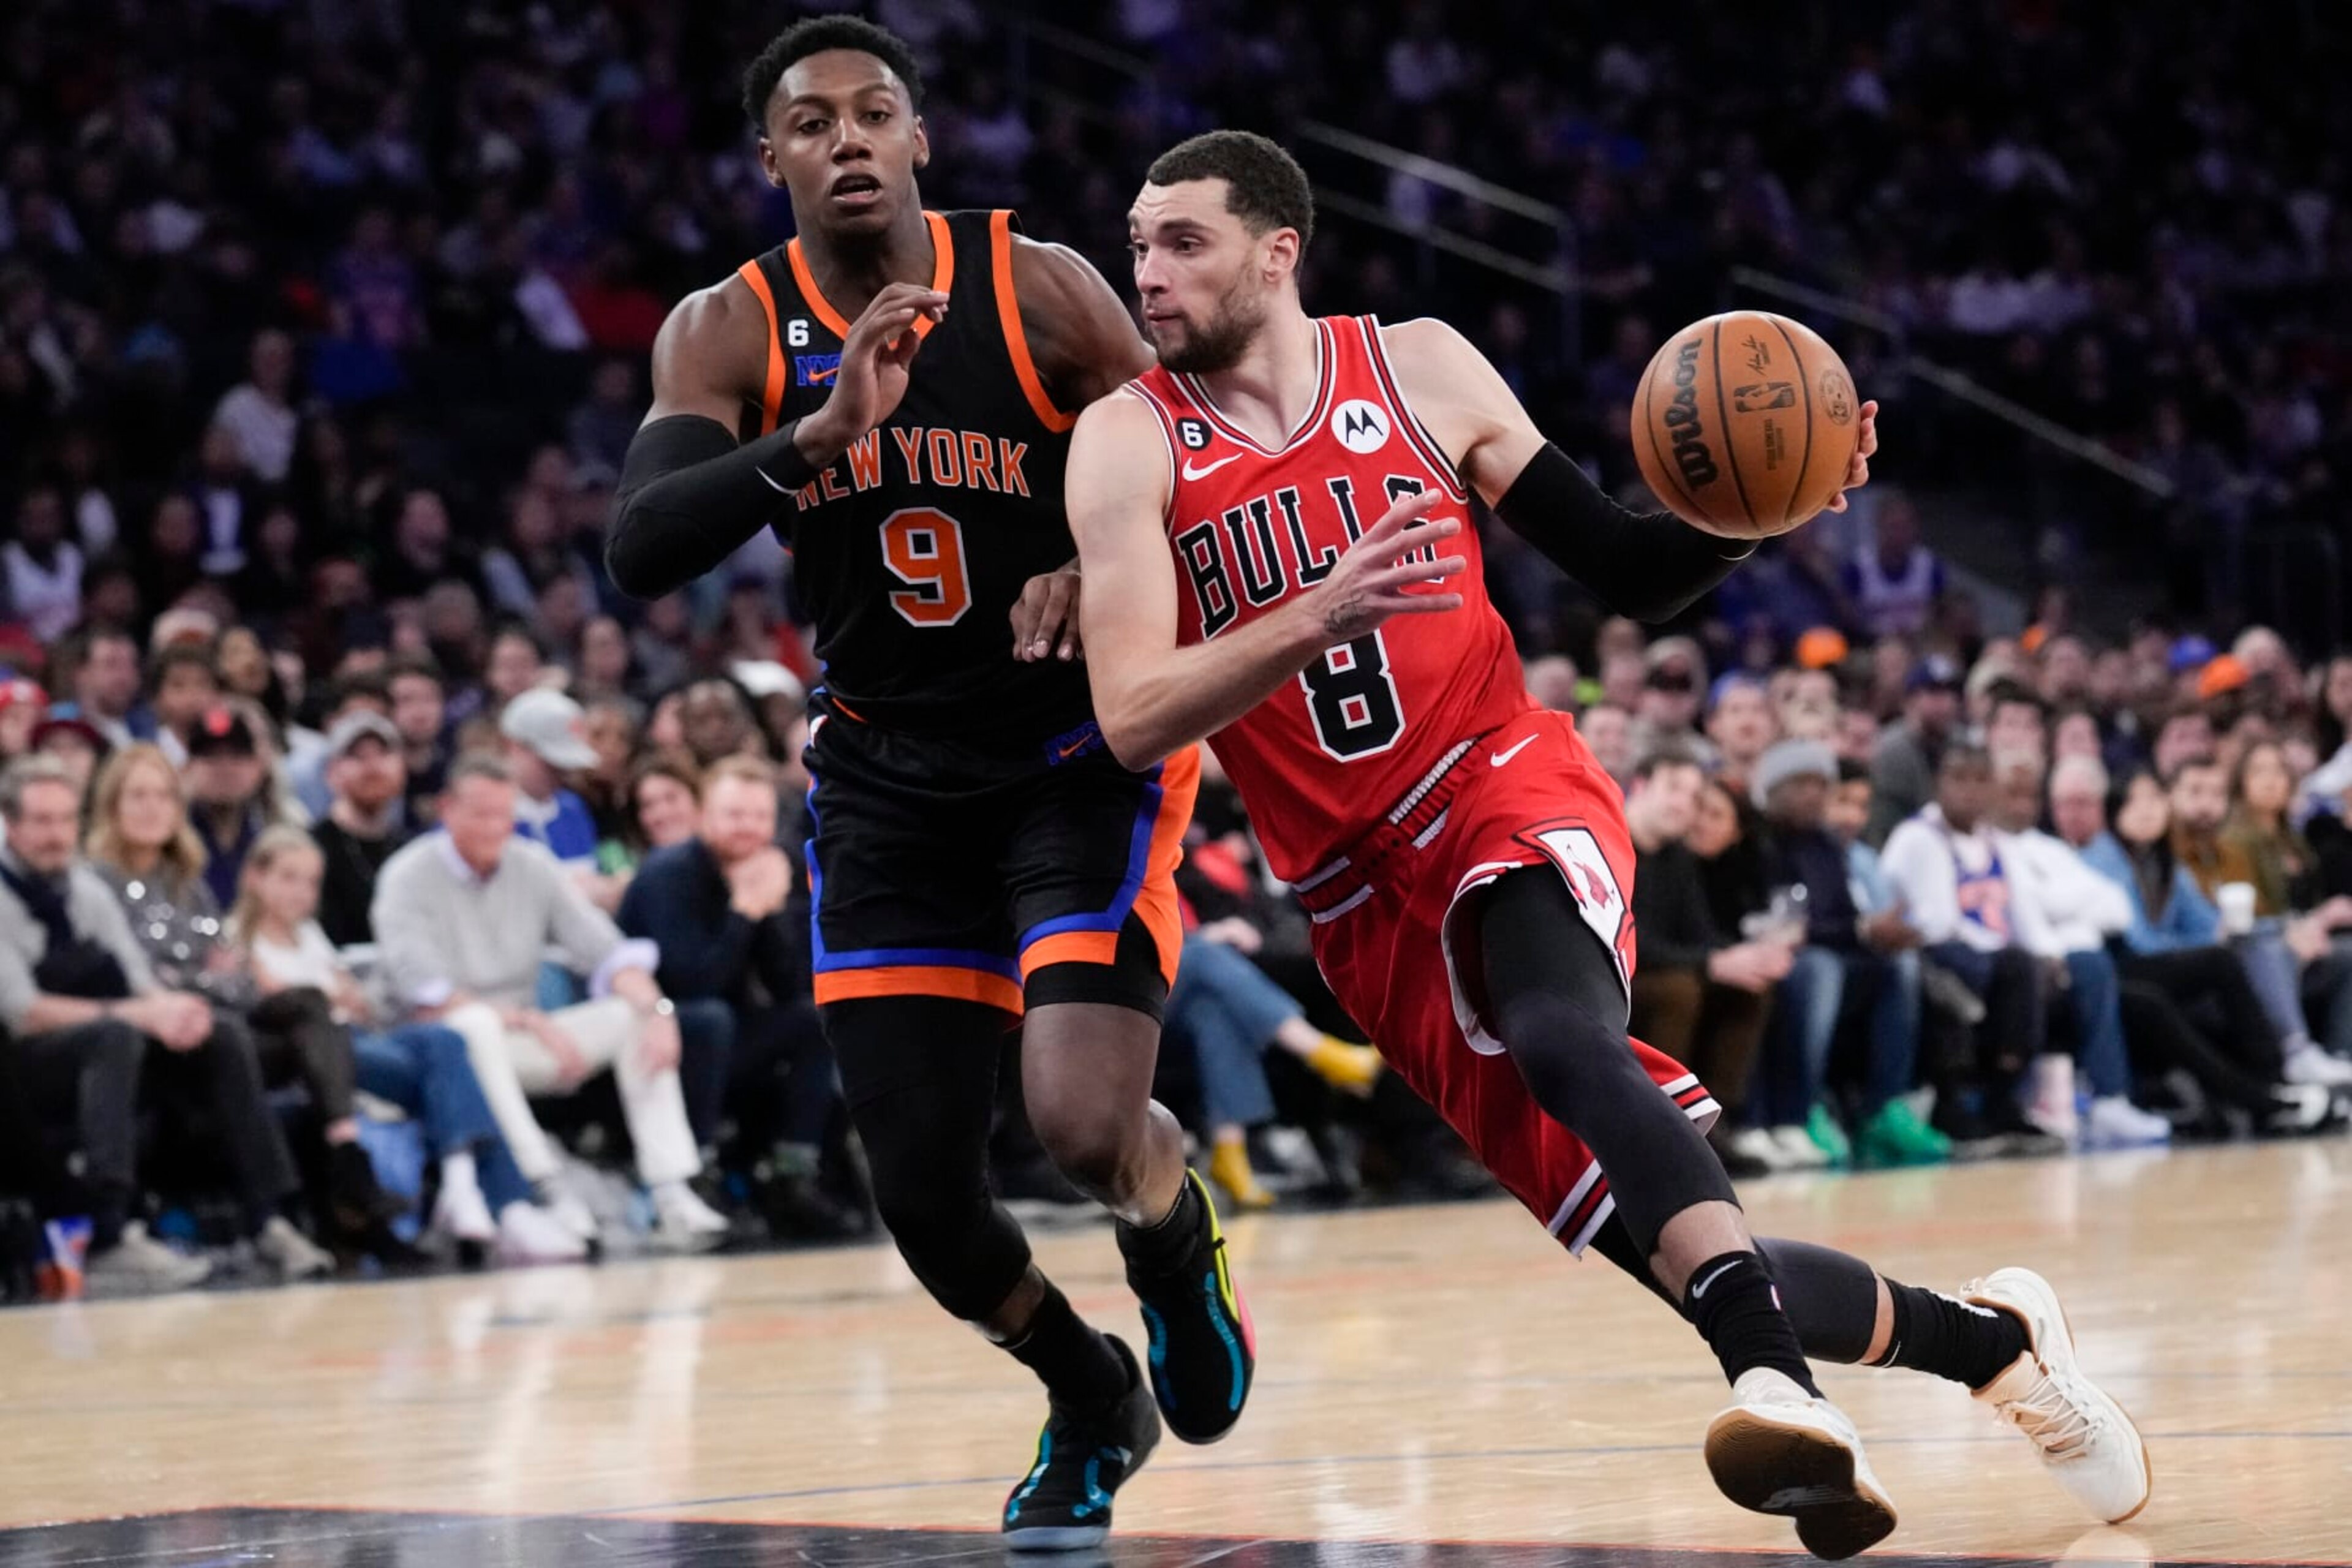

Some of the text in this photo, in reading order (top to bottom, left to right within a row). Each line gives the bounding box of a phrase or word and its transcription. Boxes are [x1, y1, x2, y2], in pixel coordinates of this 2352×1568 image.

[788, 319, 809, 347] 6
[891, 427, 1031, 498] YORK
[1182, 421, 1205, 447] 6
[1665, 339, 1719, 491] Wilson
[879, 507, 973, 627] 9
[1297, 627, 1406, 763] 8
